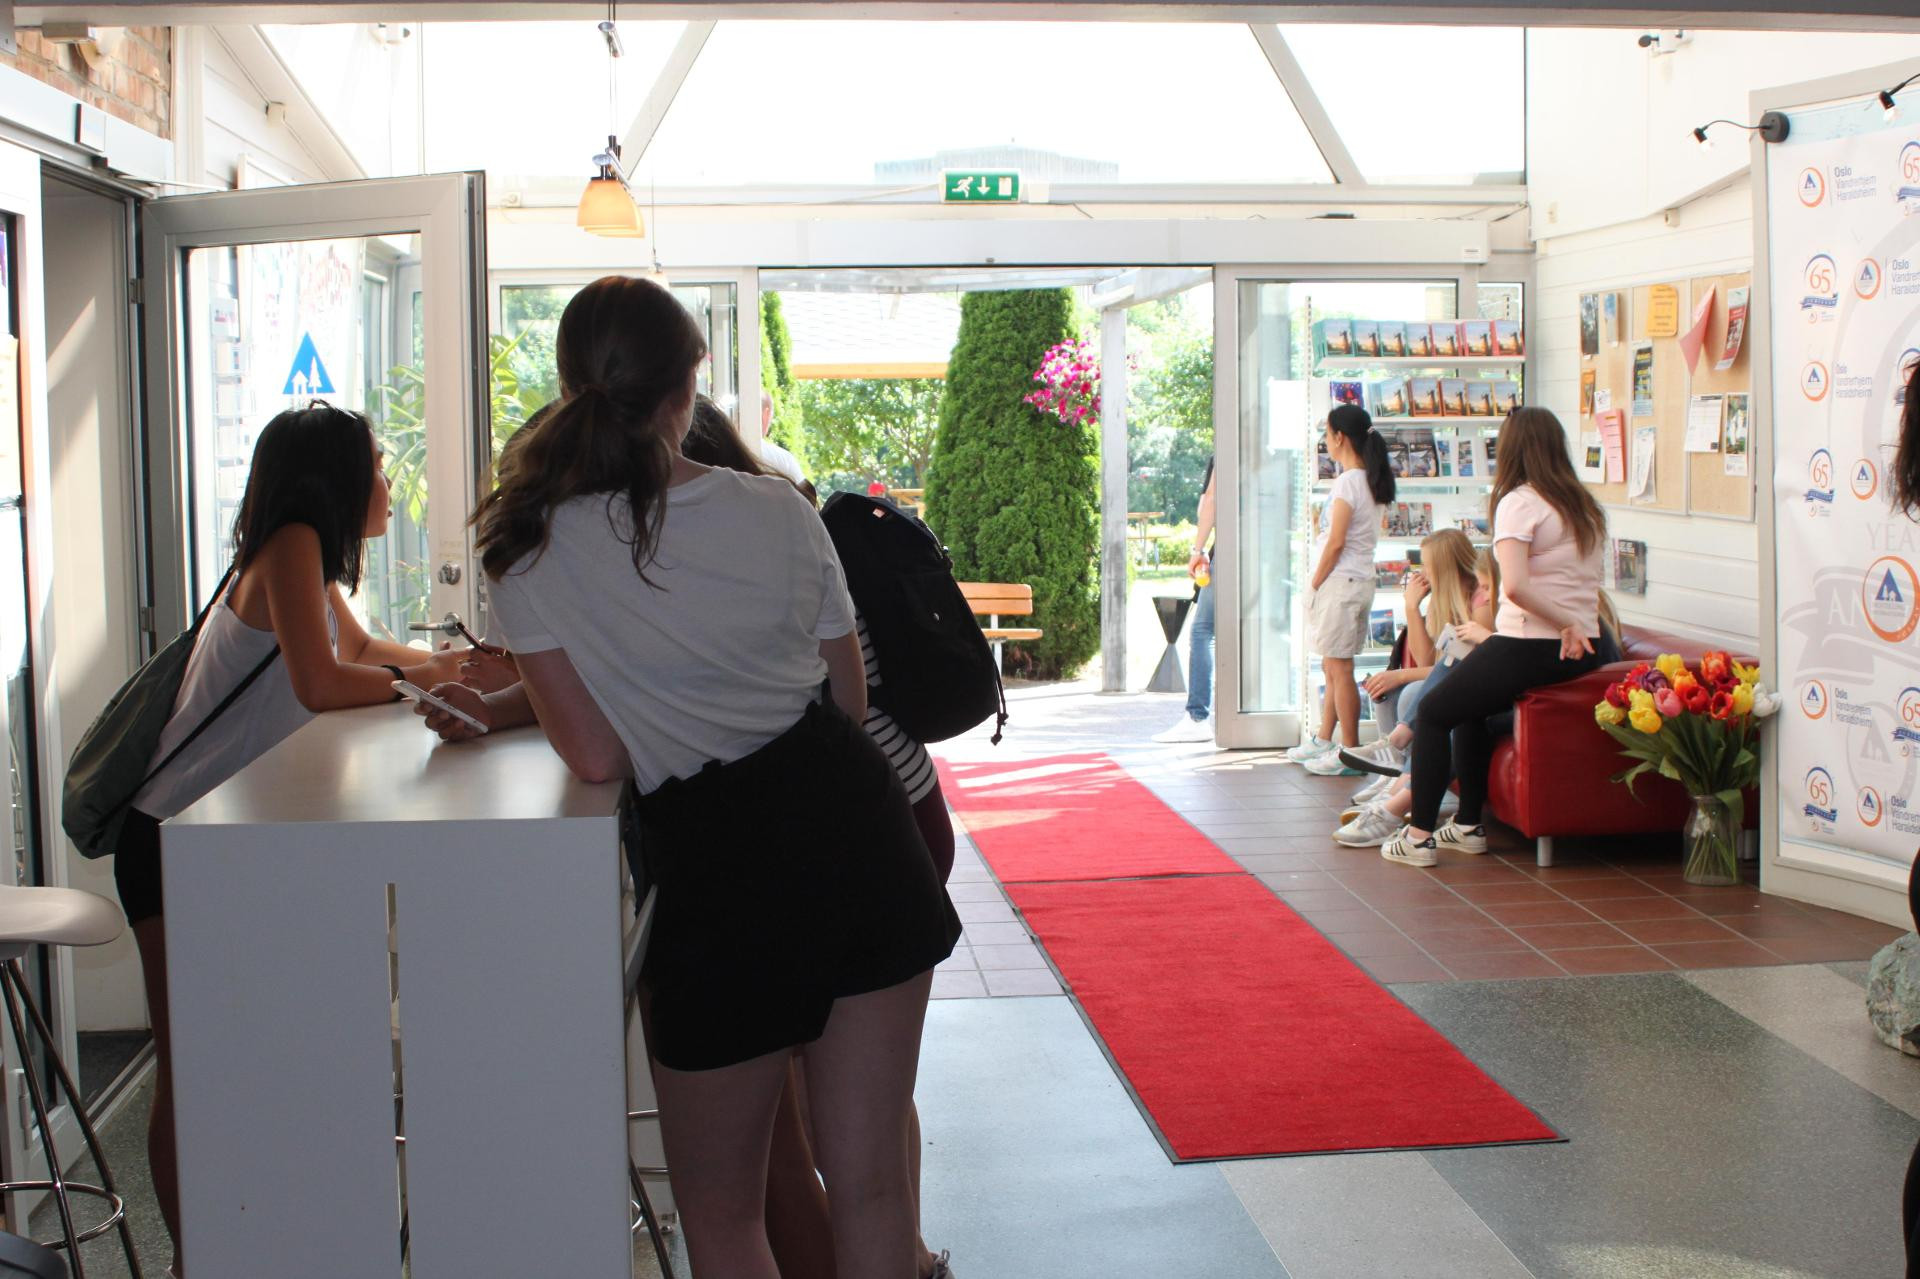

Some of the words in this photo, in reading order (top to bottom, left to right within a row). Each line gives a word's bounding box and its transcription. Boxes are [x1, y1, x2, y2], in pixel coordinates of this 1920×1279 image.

[1834, 166, 1852, 178] Oslo
[1892, 259, 1909, 271] Oslo
[1809, 264, 1831, 294] 65
[1812, 458, 1829, 489] 65
[1834, 687, 1848, 700] Oslo
[1809, 775, 1828, 807] 65
[1890, 795, 1907, 809] Oslo
